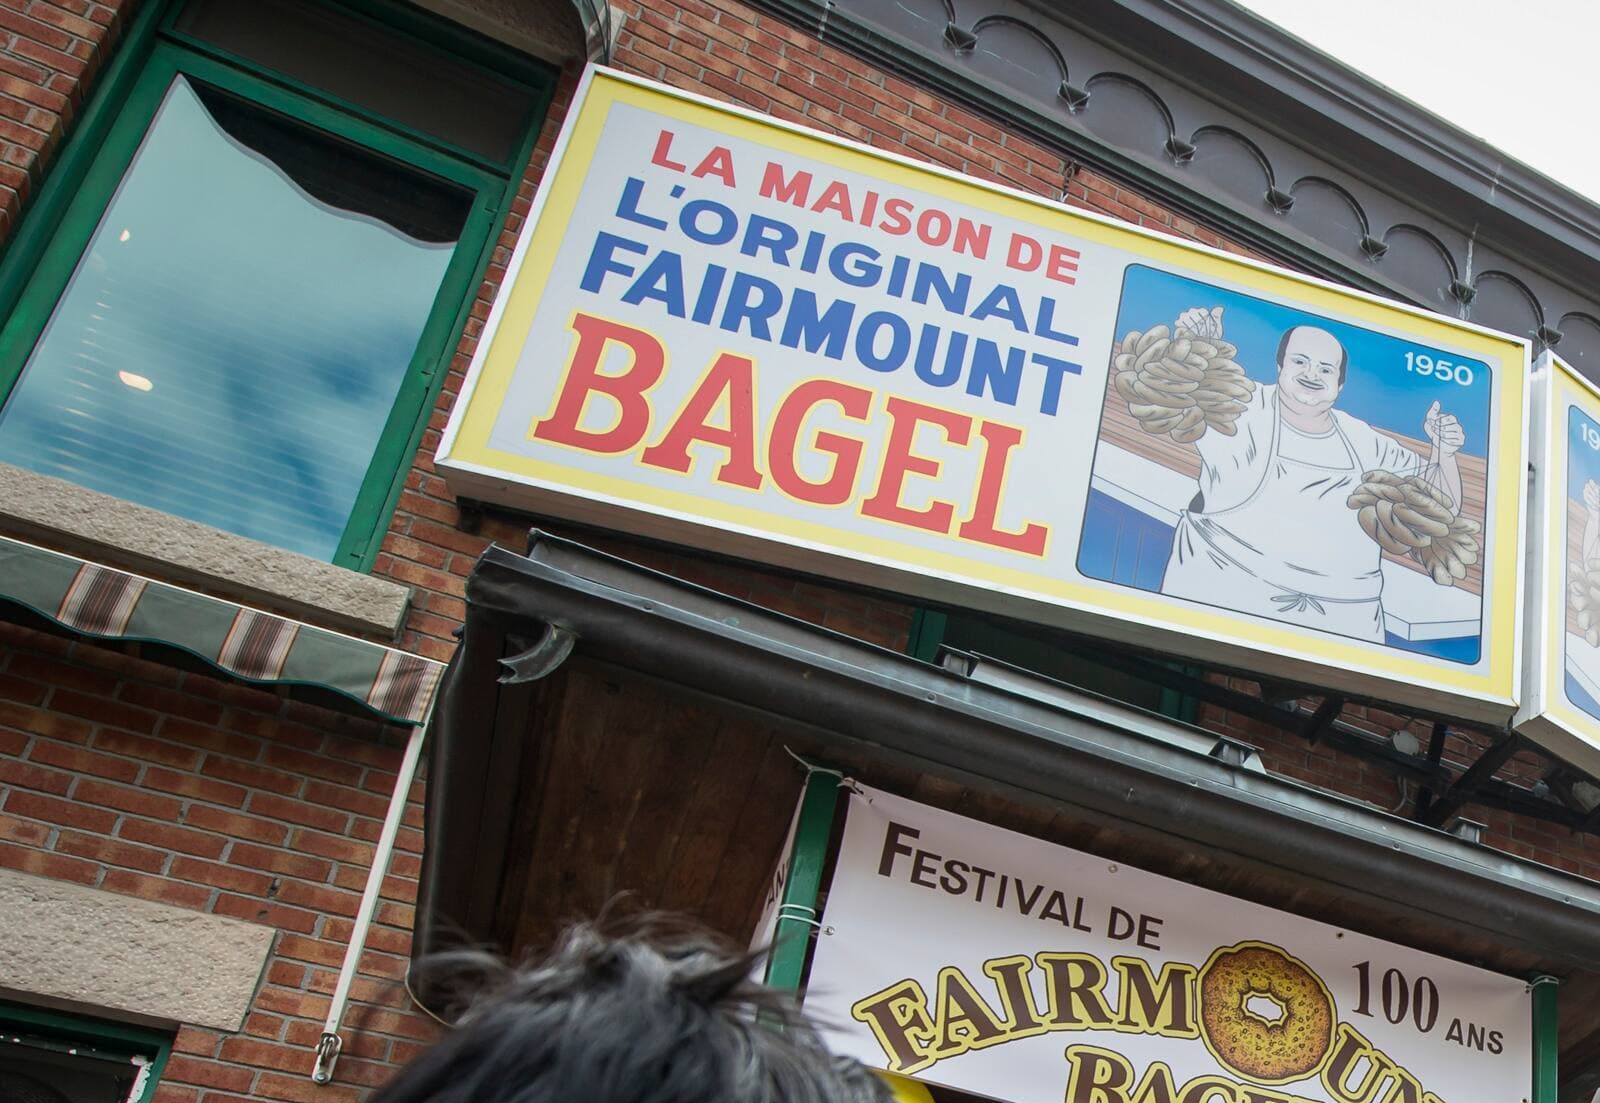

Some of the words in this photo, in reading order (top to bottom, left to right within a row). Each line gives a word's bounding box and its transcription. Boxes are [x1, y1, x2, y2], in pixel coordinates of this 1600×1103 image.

[615, 177, 1080, 347] L'ORIGINAL
[651, 130, 736, 189] LA
[758, 163, 990, 260] MAISON
[1006, 234, 1081, 286] DE
[580, 231, 1083, 416] FAIRMOUNT
[1404, 352, 1474, 386] 1950
[533, 312, 1048, 558] BAGEL
[878, 821, 1092, 933] FESTIVAL
[1107, 906, 1164, 951] DE
[1352, 961, 1440, 1032] 100
[1445, 1018, 1504, 1055] ANS
